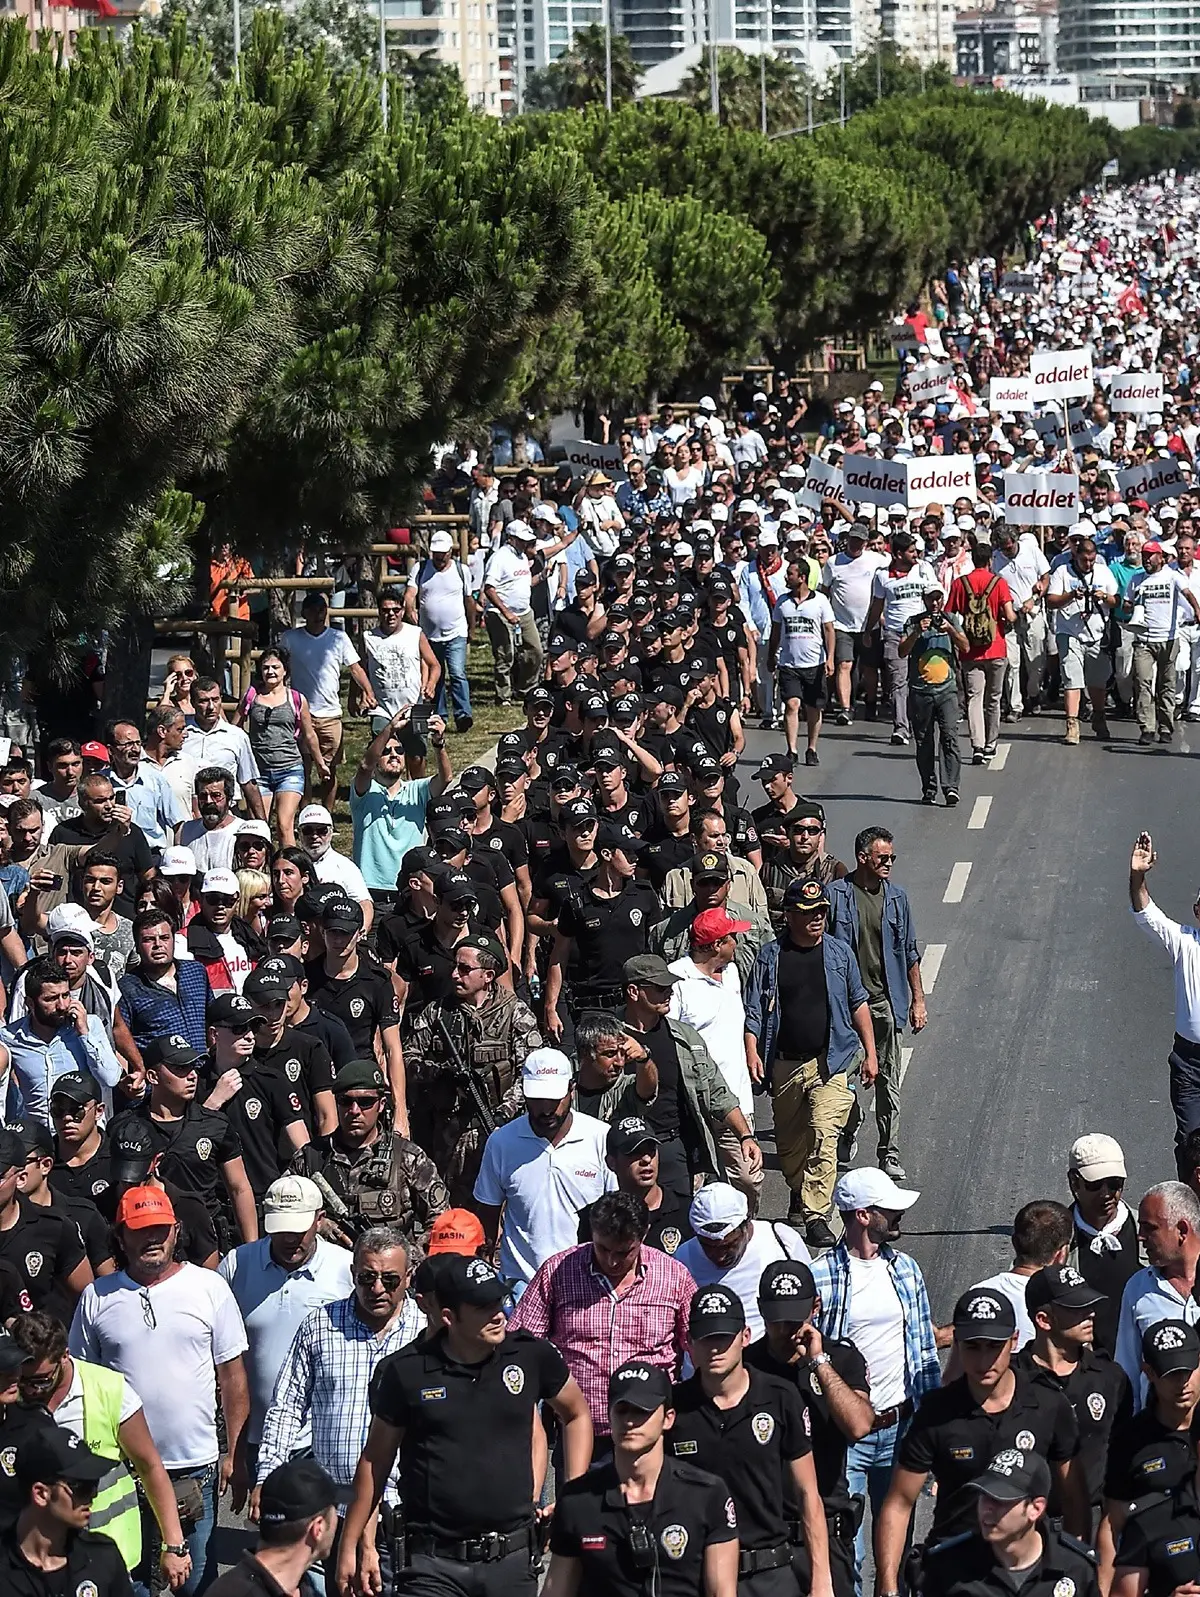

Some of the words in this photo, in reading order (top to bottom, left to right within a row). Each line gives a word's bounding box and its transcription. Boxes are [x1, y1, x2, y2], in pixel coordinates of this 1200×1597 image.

[1035, 364, 1089, 385] adalet
[996, 389, 1029, 401] adalet
[1113, 385, 1161, 400] adalet
[571, 452, 621, 471] adalet
[847, 470, 906, 494] adalet
[910, 470, 971, 491] adalet
[1125, 471, 1182, 498] adalet
[806, 478, 848, 502] adale
[1008, 490, 1075, 508] adalet
[333, 905, 352, 913] POLİS
[259, 975, 279, 984] POLİS
[61, 1074, 82, 1083] POLİS
[119, 1141, 142, 1151] POLİS
[574, 1169, 597, 1179] adalet
[134, 1200, 162, 1210] BASIN
[438, 1231, 465, 1240] BASIN
[702, 1306, 726, 1314] POLİS
[1158, 1340, 1182, 1350] POLİS
[619, 1368, 649, 1382] POLİS
